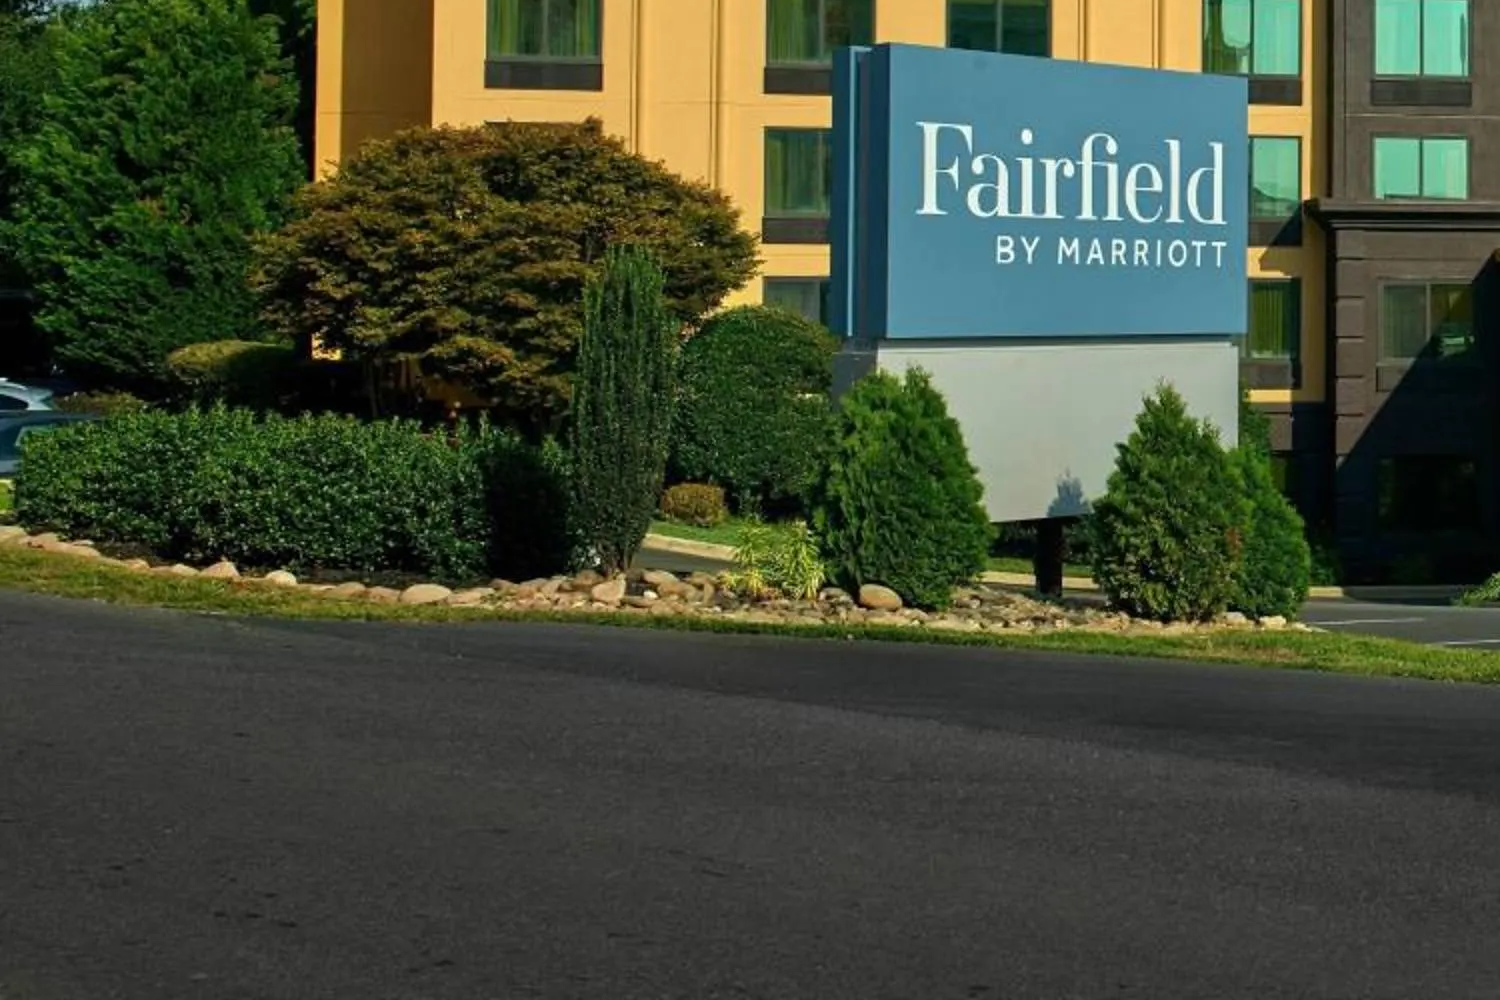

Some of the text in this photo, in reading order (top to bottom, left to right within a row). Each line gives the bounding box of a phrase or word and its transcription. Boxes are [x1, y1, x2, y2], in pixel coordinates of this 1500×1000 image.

[916, 121, 1228, 225] Fairfield
[996, 235, 1228, 268] BY MARRIOTT
